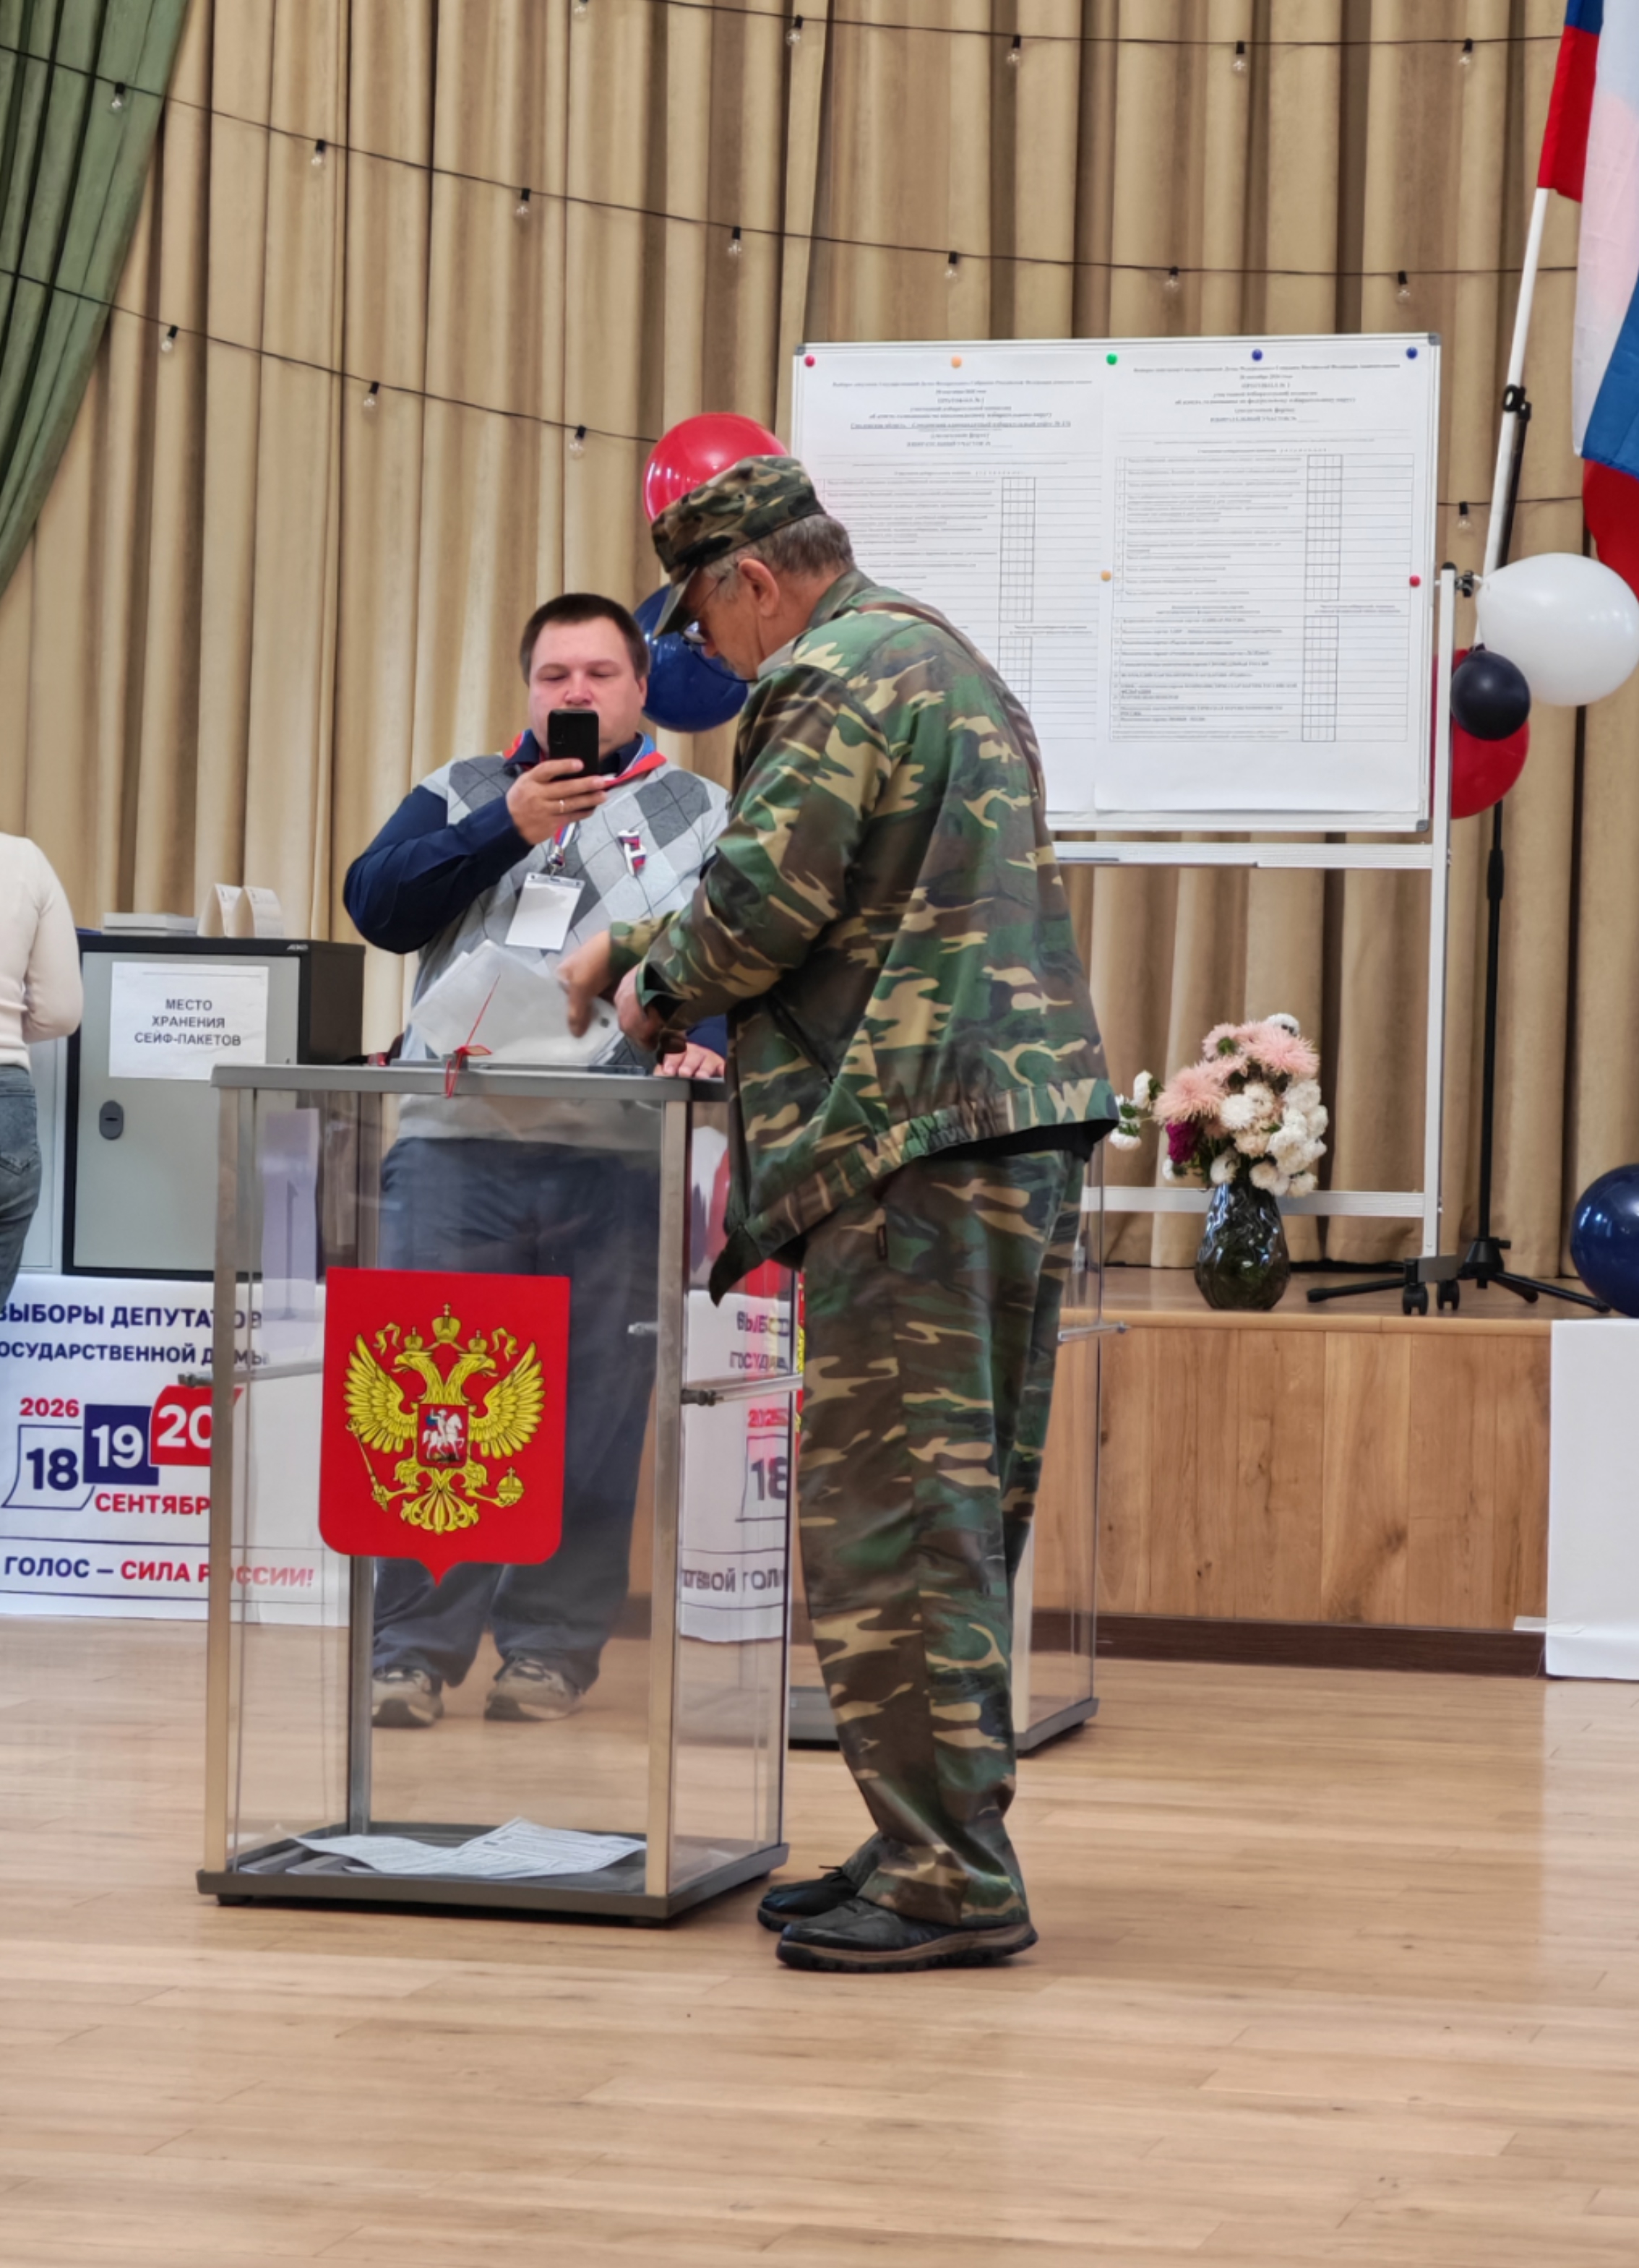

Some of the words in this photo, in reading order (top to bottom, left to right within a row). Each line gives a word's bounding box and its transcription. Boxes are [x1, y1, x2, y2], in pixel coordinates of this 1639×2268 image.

[165, 999, 212, 1010] МЕСТО
[152, 1015, 225, 1028] ХРАНЕНИЯ
[134, 1031, 241, 1046] СЕЙФ-ПАКЕТОВ
[111, 1306, 262, 1329] ДЕПУТАОВ
[0, 1341, 196, 1363] ОСУДАРСТВЕННОЙ
[201, 1347, 270, 1365] ДМЫ
[20, 1398, 79, 1417] 2026
[157, 1404, 212, 1448] 20
[91, 1425, 143, 1469] 19
[26, 1448, 79, 1491] 18
[95, 1493, 210, 1515] СЕНТЯБР
[4, 1556, 90, 1578] ГОЛОС
[121, 1560, 190, 1582] СИЛА
[198, 1563, 314, 1588] РССИИ!
